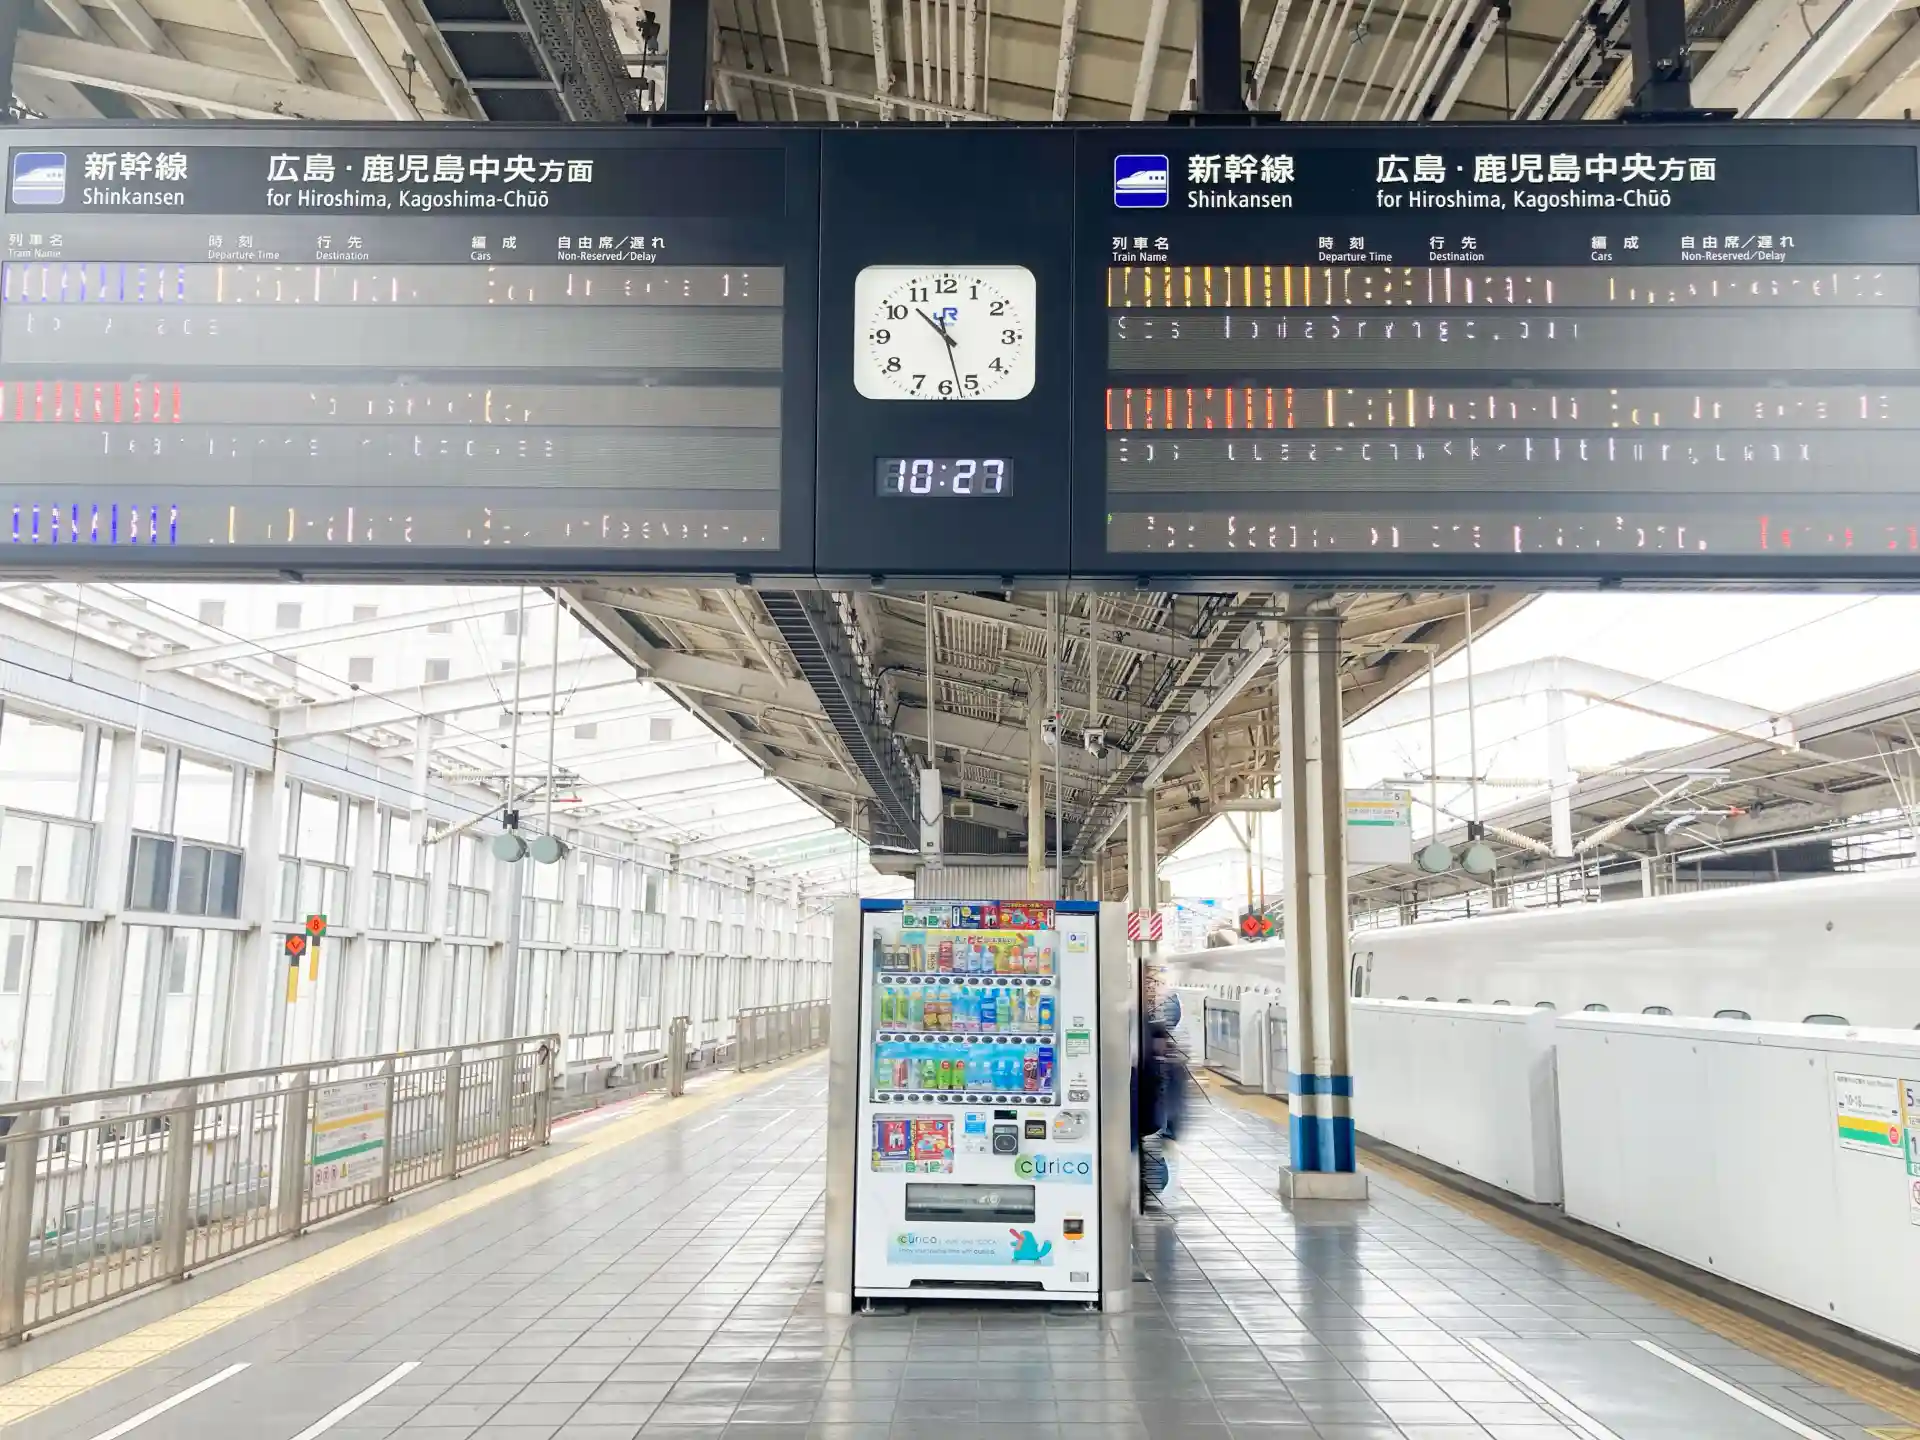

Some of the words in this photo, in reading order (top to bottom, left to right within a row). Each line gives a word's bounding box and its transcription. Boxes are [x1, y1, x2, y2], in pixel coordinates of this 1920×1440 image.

[84, 151, 188, 181] 新幹線
[266, 153, 594, 184] 広島・鹿児島中央方面
[1188, 153, 1295, 184] 新幹線
[1376, 153, 1717, 184] 広島・鹿児島中央方面
[83, 187, 185, 206] Shinkansen
[267, 188, 292, 207] for
[298, 188, 392, 210] Hiroshima,
[399, 189, 549, 212] Kagoshima-Chūō
[1188, 189, 1293, 208] Shinkansen
[1376, 190, 1401, 208] for
[1409, 189, 1506, 211] Hiroshima,
[1514, 189, 1672, 213] Kagoshima-Chūō
[208, 250, 256, 262] Departure
[257, 250, 280, 260] Time
[316, 251, 369, 260] Destination
[471, 251, 492, 260] Cars
[1112, 252, 1137, 262] Train
[1139, 252, 1168, 262] Name
[1318, 252, 1367, 264] Departure
[1368, 252, 1393, 262] Time
[1429, 252, 1485, 262] Destination
[1591, 251, 1613, 261] Cars
[909, 287, 929, 302] 11
[934, 279, 958, 294] 12
[970, 286, 979, 300] 1
[886, 304, 908, 320] 10
[933, 307, 958, 321] JR
[990, 301, 1005, 317] 2
[876, 329, 891, 345] 9
[1001, 329, 1016, 345] 3
[886, 357, 901, 372] 8
[988, 357, 1004, 372] 4
[912, 374, 927, 390] 7
[938, 380, 953, 396] 6
[964, 374, 979, 390] 5
[897, 459, 1005, 494] 10:27
[1906, 1088, 1914, 1107] 5
[1020, 1158, 1090, 1175] curico
